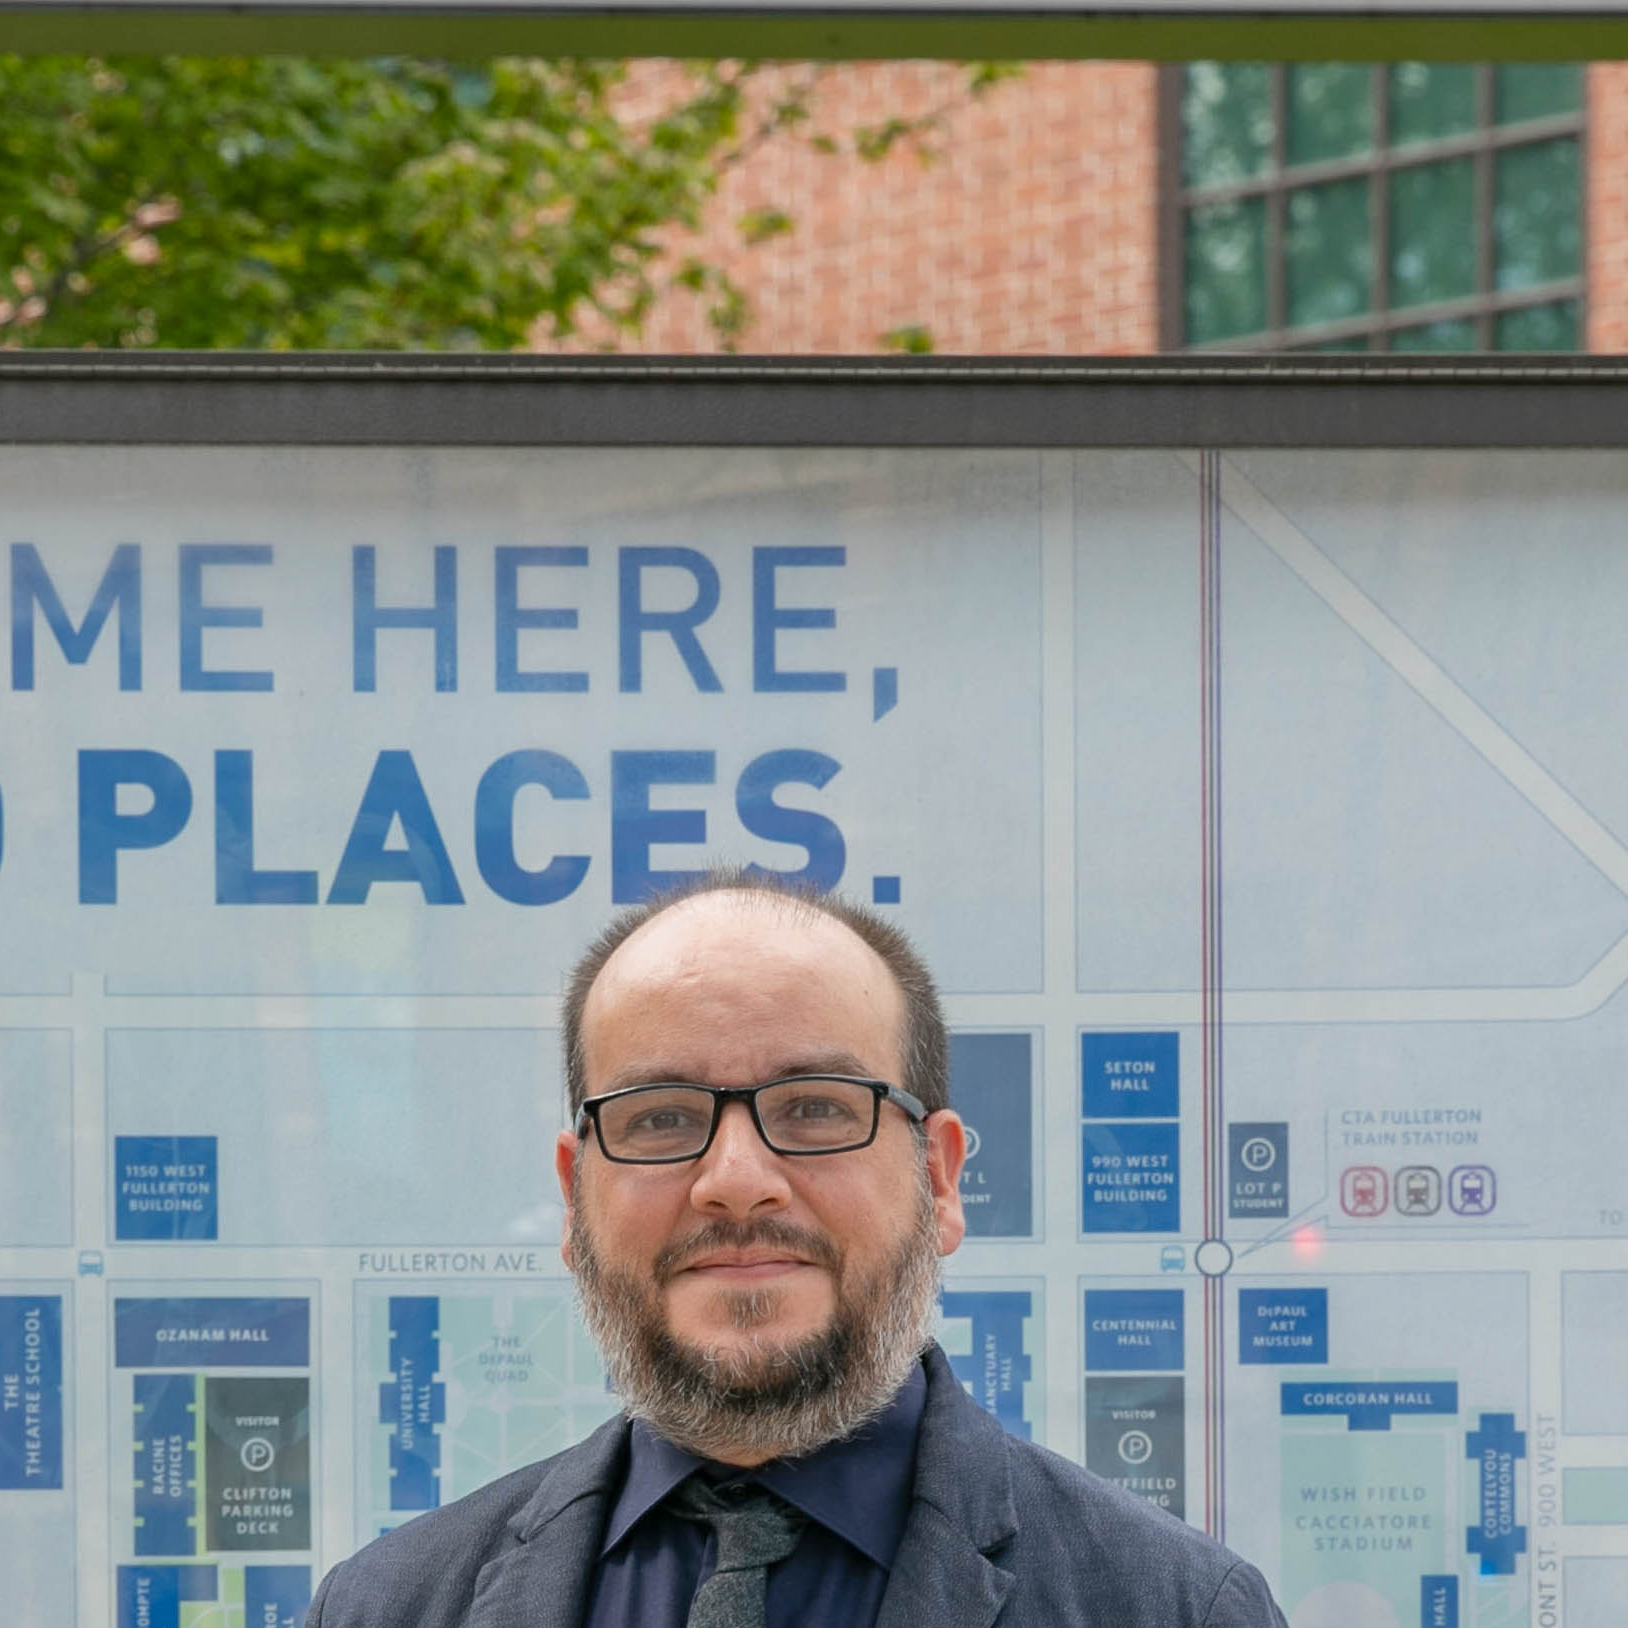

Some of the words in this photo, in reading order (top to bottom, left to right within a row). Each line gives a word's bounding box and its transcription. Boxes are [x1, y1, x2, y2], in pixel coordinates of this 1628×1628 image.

[353, 543, 898, 723] HERE,
[76, 746, 902, 906] PLACES.
[1104, 1061, 1155, 1074] SETON
[1111, 1078, 1149, 1090] HALL
[1341, 1111, 1375, 1126] CTA
[1380, 1109, 1482, 1125] FULLERTON
[1342, 1130, 1394, 1146] TRAIN
[1402, 1129, 1478, 1145] STATION
[1092, 1156, 1121, 1168] 990
[1126, 1155, 1168, 1167] WEST
[125, 1164, 158, 1177] 1150
[164, 1164, 206, 1177] WEST
[1088, 1172, 1173, 1185] FULLERTON
[122, 1181, 210, 1194] FULLERTON
[1236, 1182, 1266, 1195] LOT
[1094, 1190, 1167, 1202] BUILDING
[129, 1199, 203, 1212] BUILDING
[1233, 1199, 1284, 1208] STUDENT
[1599, 1209, 1621, 1225] TO
[358, 1253, 486, 1273] FULLERTON
[495, 1252, 543, 1272] AVE.
[1092, 1320, 1177, 1331] CENTENNIAL
[1269, 1321, 1296, 1332] ART
[156, 1329, 225, 1342] OZANAM
[229, 1328, 269, 1341] HALL
[492, 1336, 521, 1348] THE
[1117, 1334, 1151, 1345] HALL
[1253, 1335, 1313, 1347] MUSEUM
[26, 1308, 40, 1386] SCHOOL
[484, 1370, 529, 1383] QUAD
[1001, 1357, 1012, 1391] HALL
[5, 1373, 19, 1411] THE
[401, 1357, 414, 1450] UNIVERSITY
[418, 1385, 430, 1423] HALL
[1303, 1393, 1389, 1406] CORCORAN
[1394, 1393, 1433, 1405] HALL
[235, 1416, 279, 1426] VISITOR
[1112, 1409, 1156, 1420] VISITOR
[26, 1391, 41, 1476] THEATRE
[1537, 1414, 1556, 1477] WEST
[153, 1437, 164, 1495] RACINE
[169, 1435, 182, 1498] OFFICES
[222, 1487, 292, 1500] CLIFTON
[1301, 1487, 1357, 1502] WISH
[1368, 1487, 1427, 1502] FIELD
[1484, 1448, 1497, 1539] CORTELYOU
[1499, 1452, 1511, 1535] COMMONS
[221, 1505, 294, 1518] PARKING
[1537, 1483, 1556, 1528] 900
[236, 1522, 279, 1535] DECK
[1296, 1515, 1432, 1531] CACCIATORE
[1314, 1537, 1413, 1551] STADIUM
[1538, 1541, 1556, 1577] ST.
[1433, 1587, 1446, 1627] HALL
